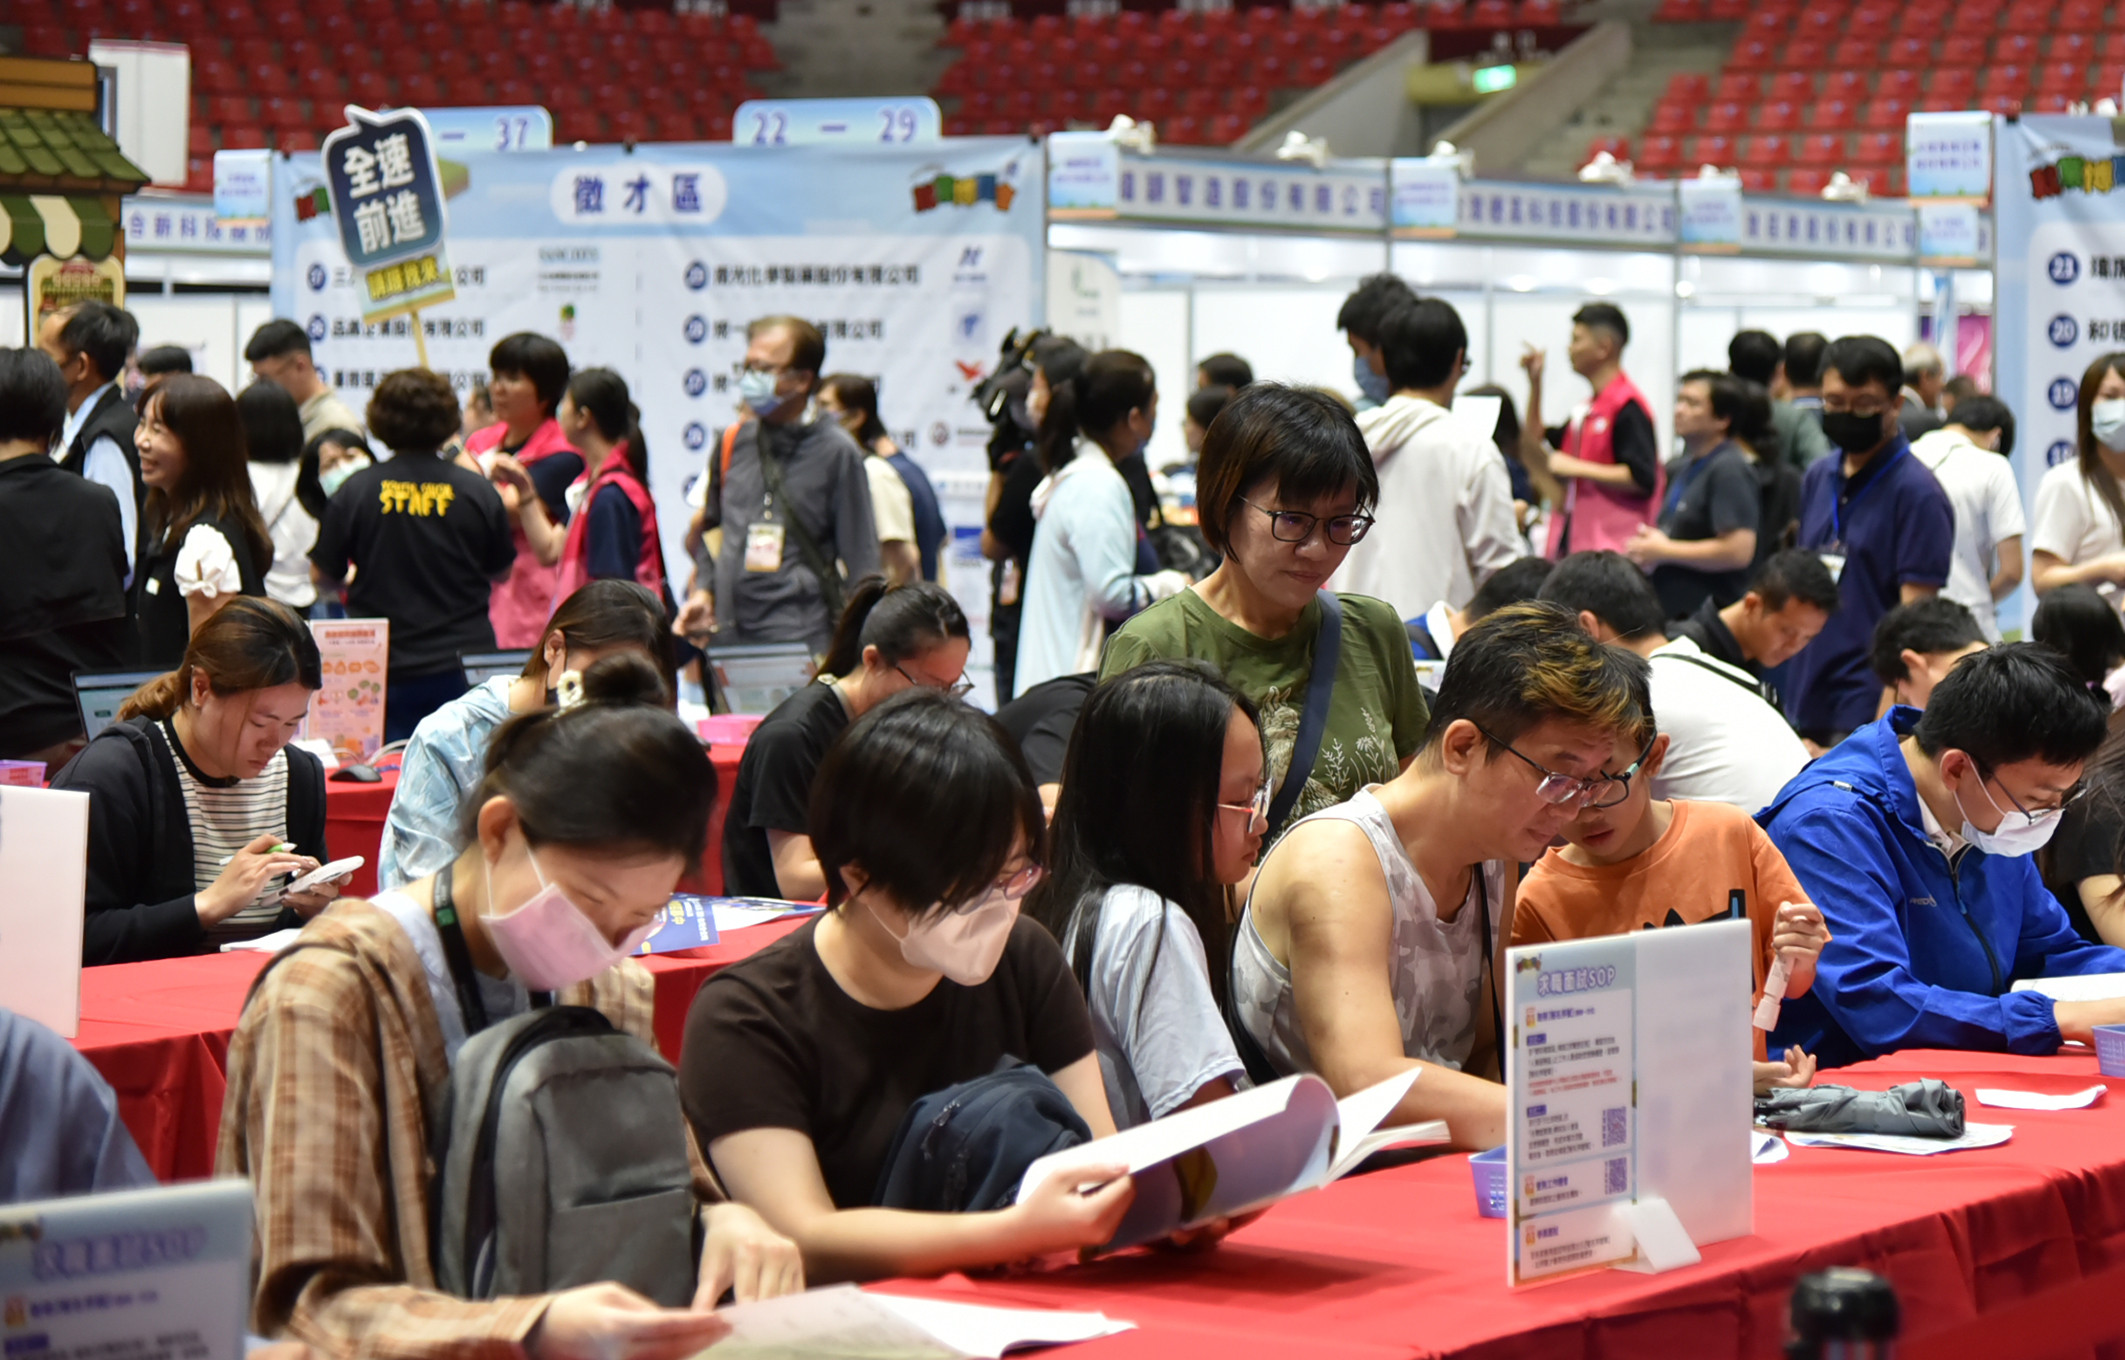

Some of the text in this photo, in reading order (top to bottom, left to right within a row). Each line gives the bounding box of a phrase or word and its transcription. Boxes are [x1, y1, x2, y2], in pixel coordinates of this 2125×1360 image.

[494, 117, 530, 150] 37
[751, 111, 787, 146] 22
[879, 108, 916, 143] 29
[342, 132, 416, 199] 全速
[353, 188, 427, 256] 前進
[379, 490, 452, 517] STAFF
[1537, 964, 1617, 997] 求職面試SOP
